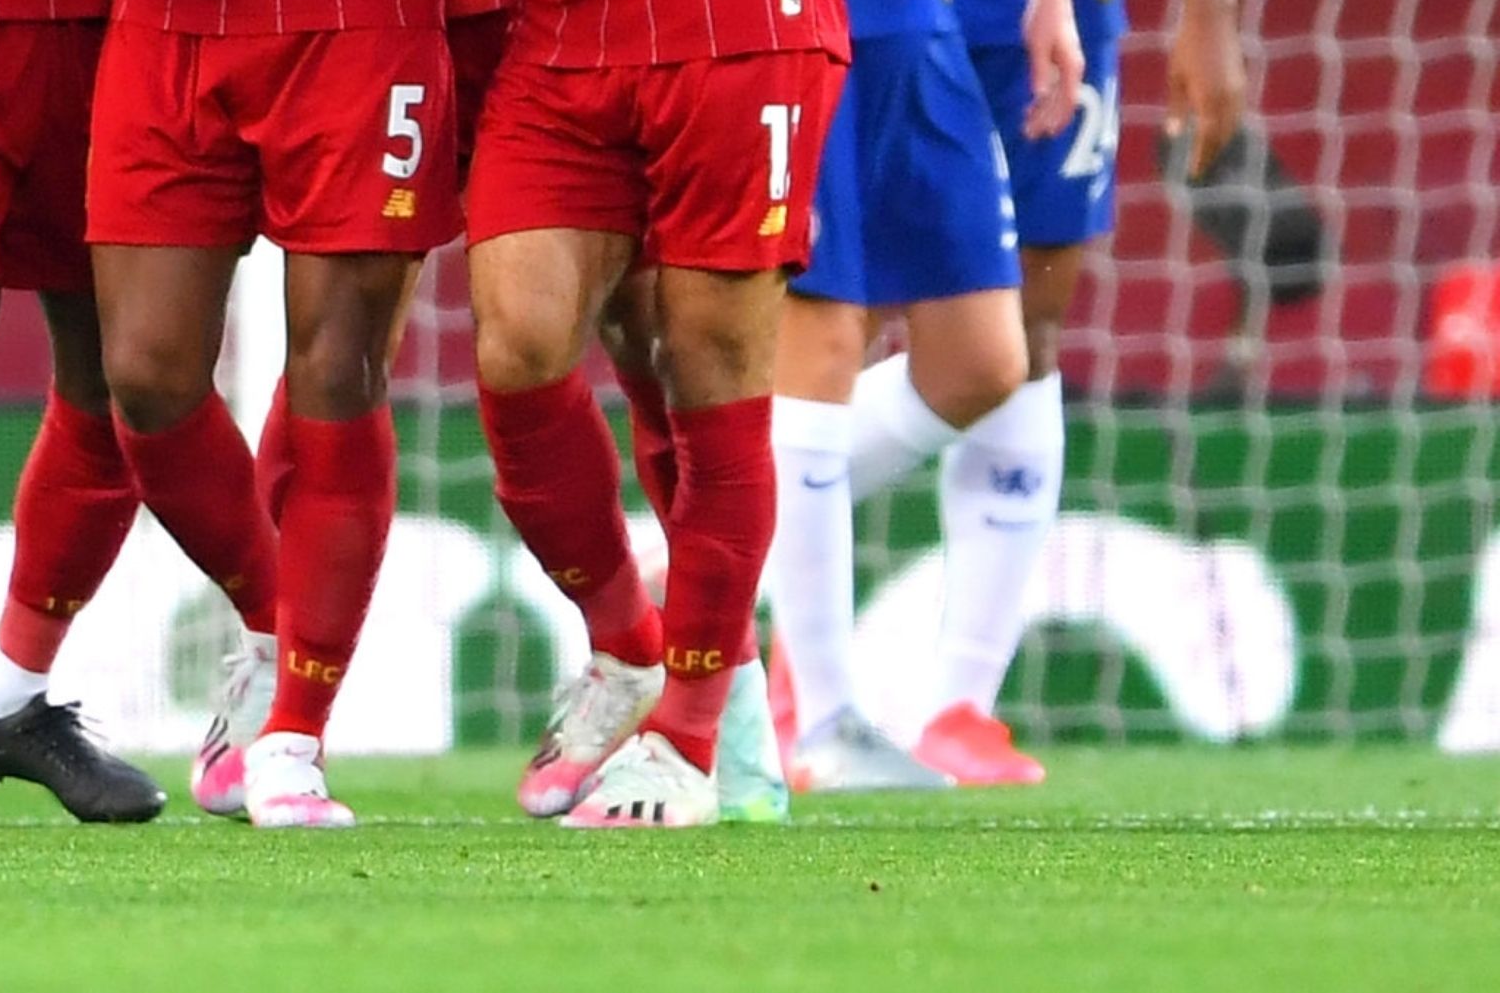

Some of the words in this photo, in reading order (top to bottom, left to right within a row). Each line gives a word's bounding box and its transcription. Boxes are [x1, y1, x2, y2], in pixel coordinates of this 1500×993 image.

[382, 84, 425, 179] 5
[760, 104, 802, 201] 1
[547, 568, 590, 585] FC
[287, 649, 343, 684] LFC
[666, 646, 724, 670] LFC
